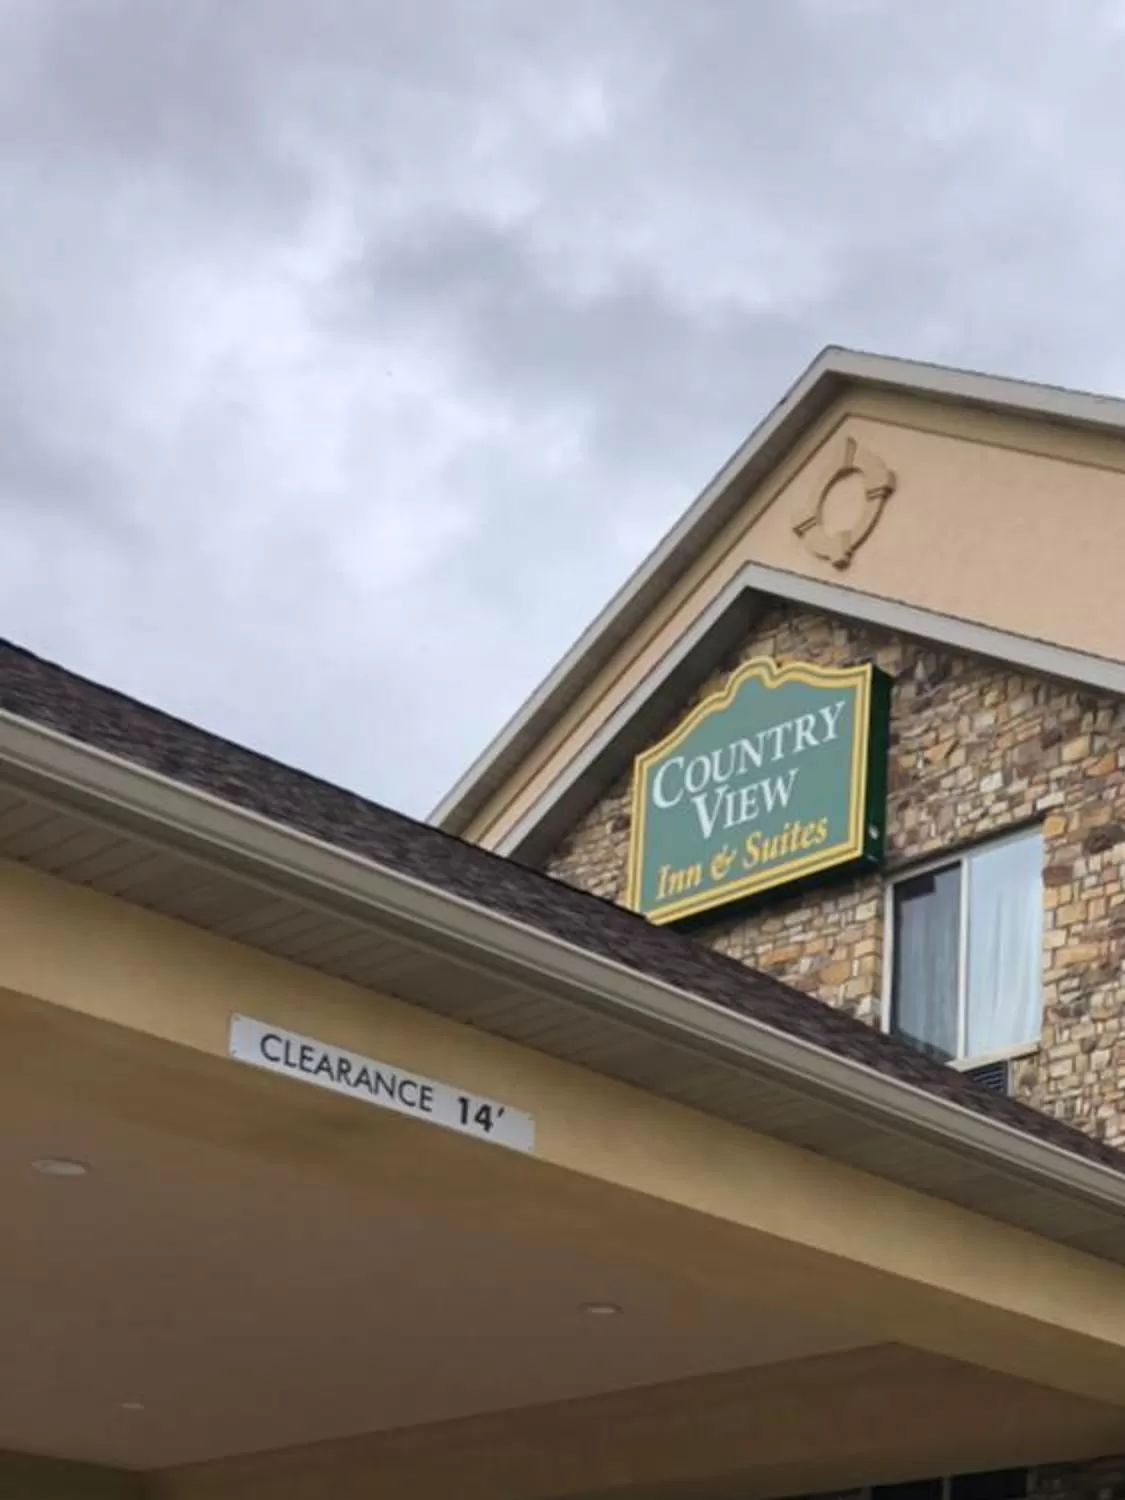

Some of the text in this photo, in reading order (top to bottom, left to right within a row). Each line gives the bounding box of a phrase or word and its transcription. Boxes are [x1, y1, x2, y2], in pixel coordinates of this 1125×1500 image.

[652, 700, 846, 809] COUNTRY
[690, 768, 799, 840] VIEW
[656, 817, 828, 899] Inn & Suites
[259, 1033, 505, 1133] CLEARANCE 14'
